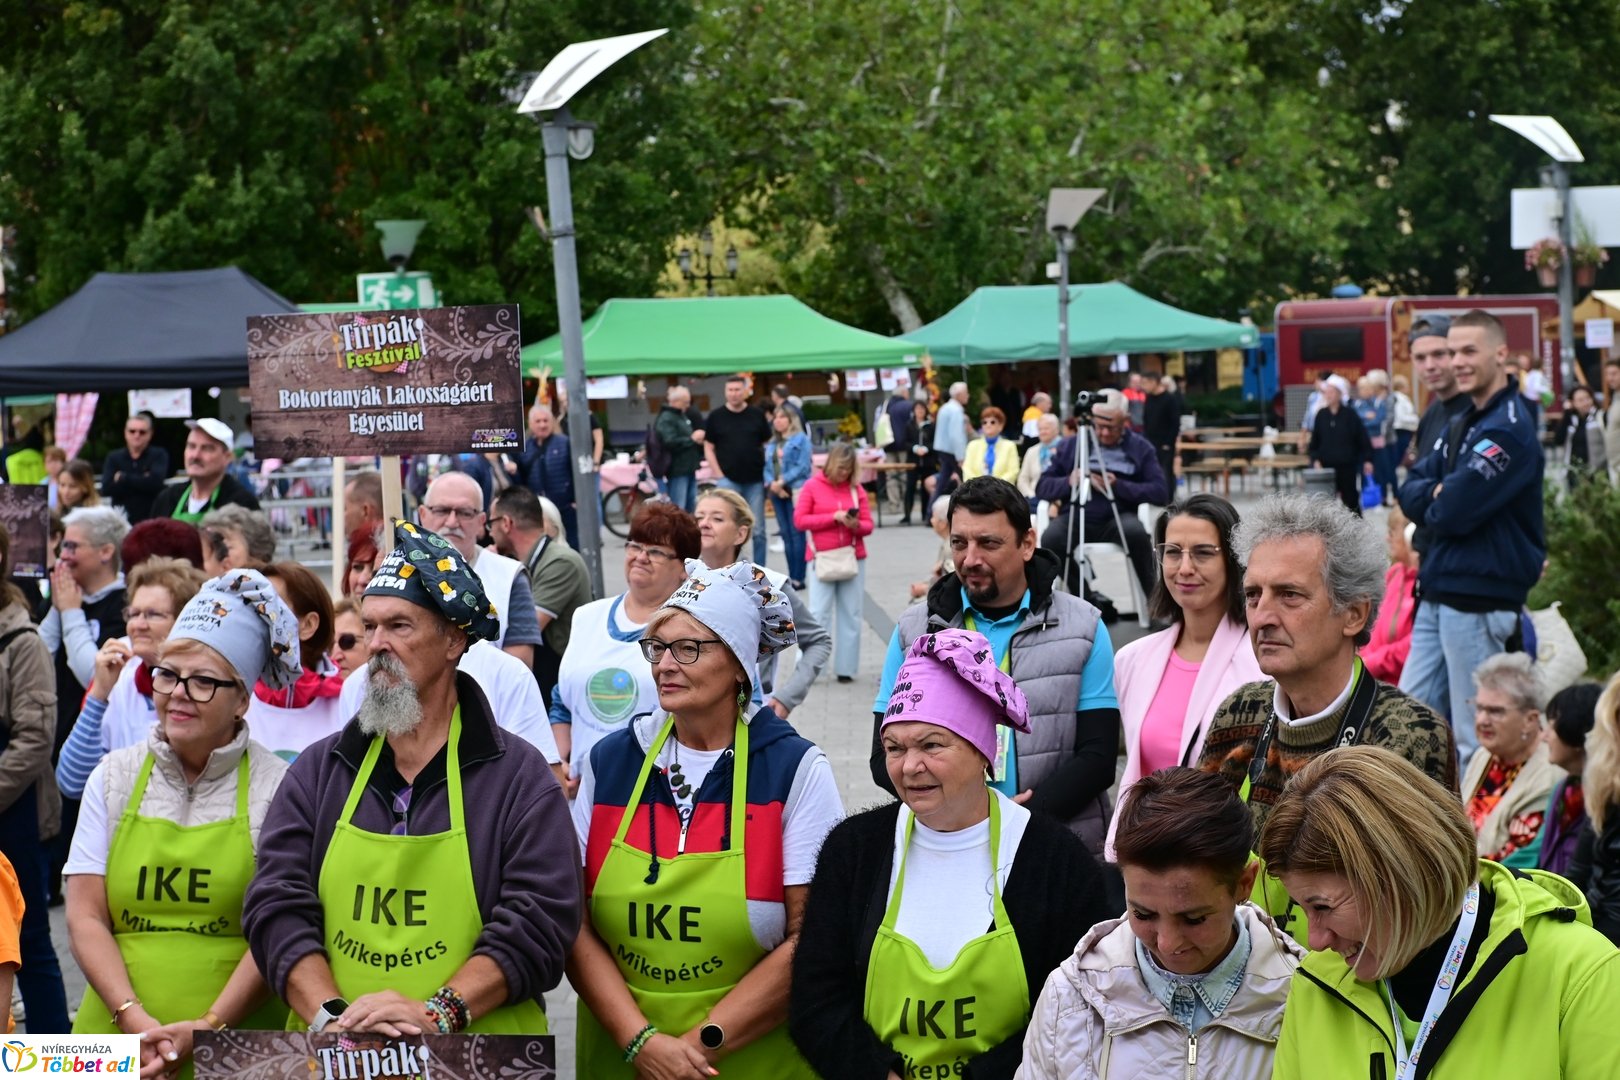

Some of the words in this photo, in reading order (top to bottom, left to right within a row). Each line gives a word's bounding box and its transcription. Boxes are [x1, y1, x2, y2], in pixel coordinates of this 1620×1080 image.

[346, 342, 420, 369] Fesztivál
[279, 385, 382, 410] Bokortanyák
[386, 380, 494, 406] Lakosságáért
[349, 412, 424, 435] Egyesület
[137, 866, 211, 904] IKE
[353, 884, 427, 926] IKE
[628, 901, 702, 943] IKE
[333, 929, 448, 972] Mikepércs
[617, 943, 724, 985] Mikepércs
[899, 995, 977, 1040] IKE
